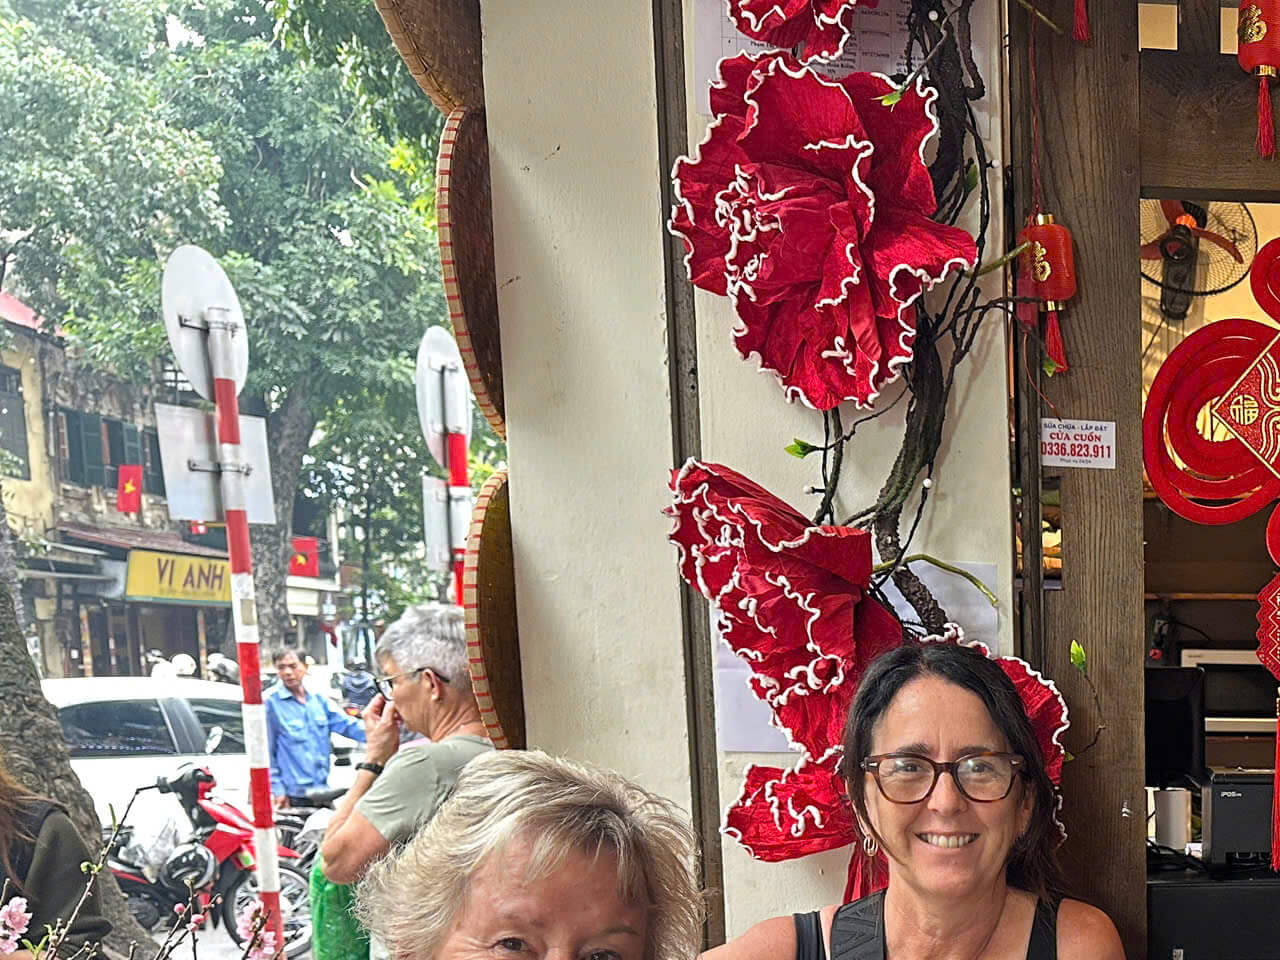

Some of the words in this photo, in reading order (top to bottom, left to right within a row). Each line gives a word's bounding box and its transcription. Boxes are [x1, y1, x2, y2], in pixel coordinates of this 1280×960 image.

[1073, 431, 1102, 442] CUỐN
[1040, 441, 1111, 459] 0336.823.911
[157, 558, 175, 586] VI
[183, 563, 225, 591] ANH
